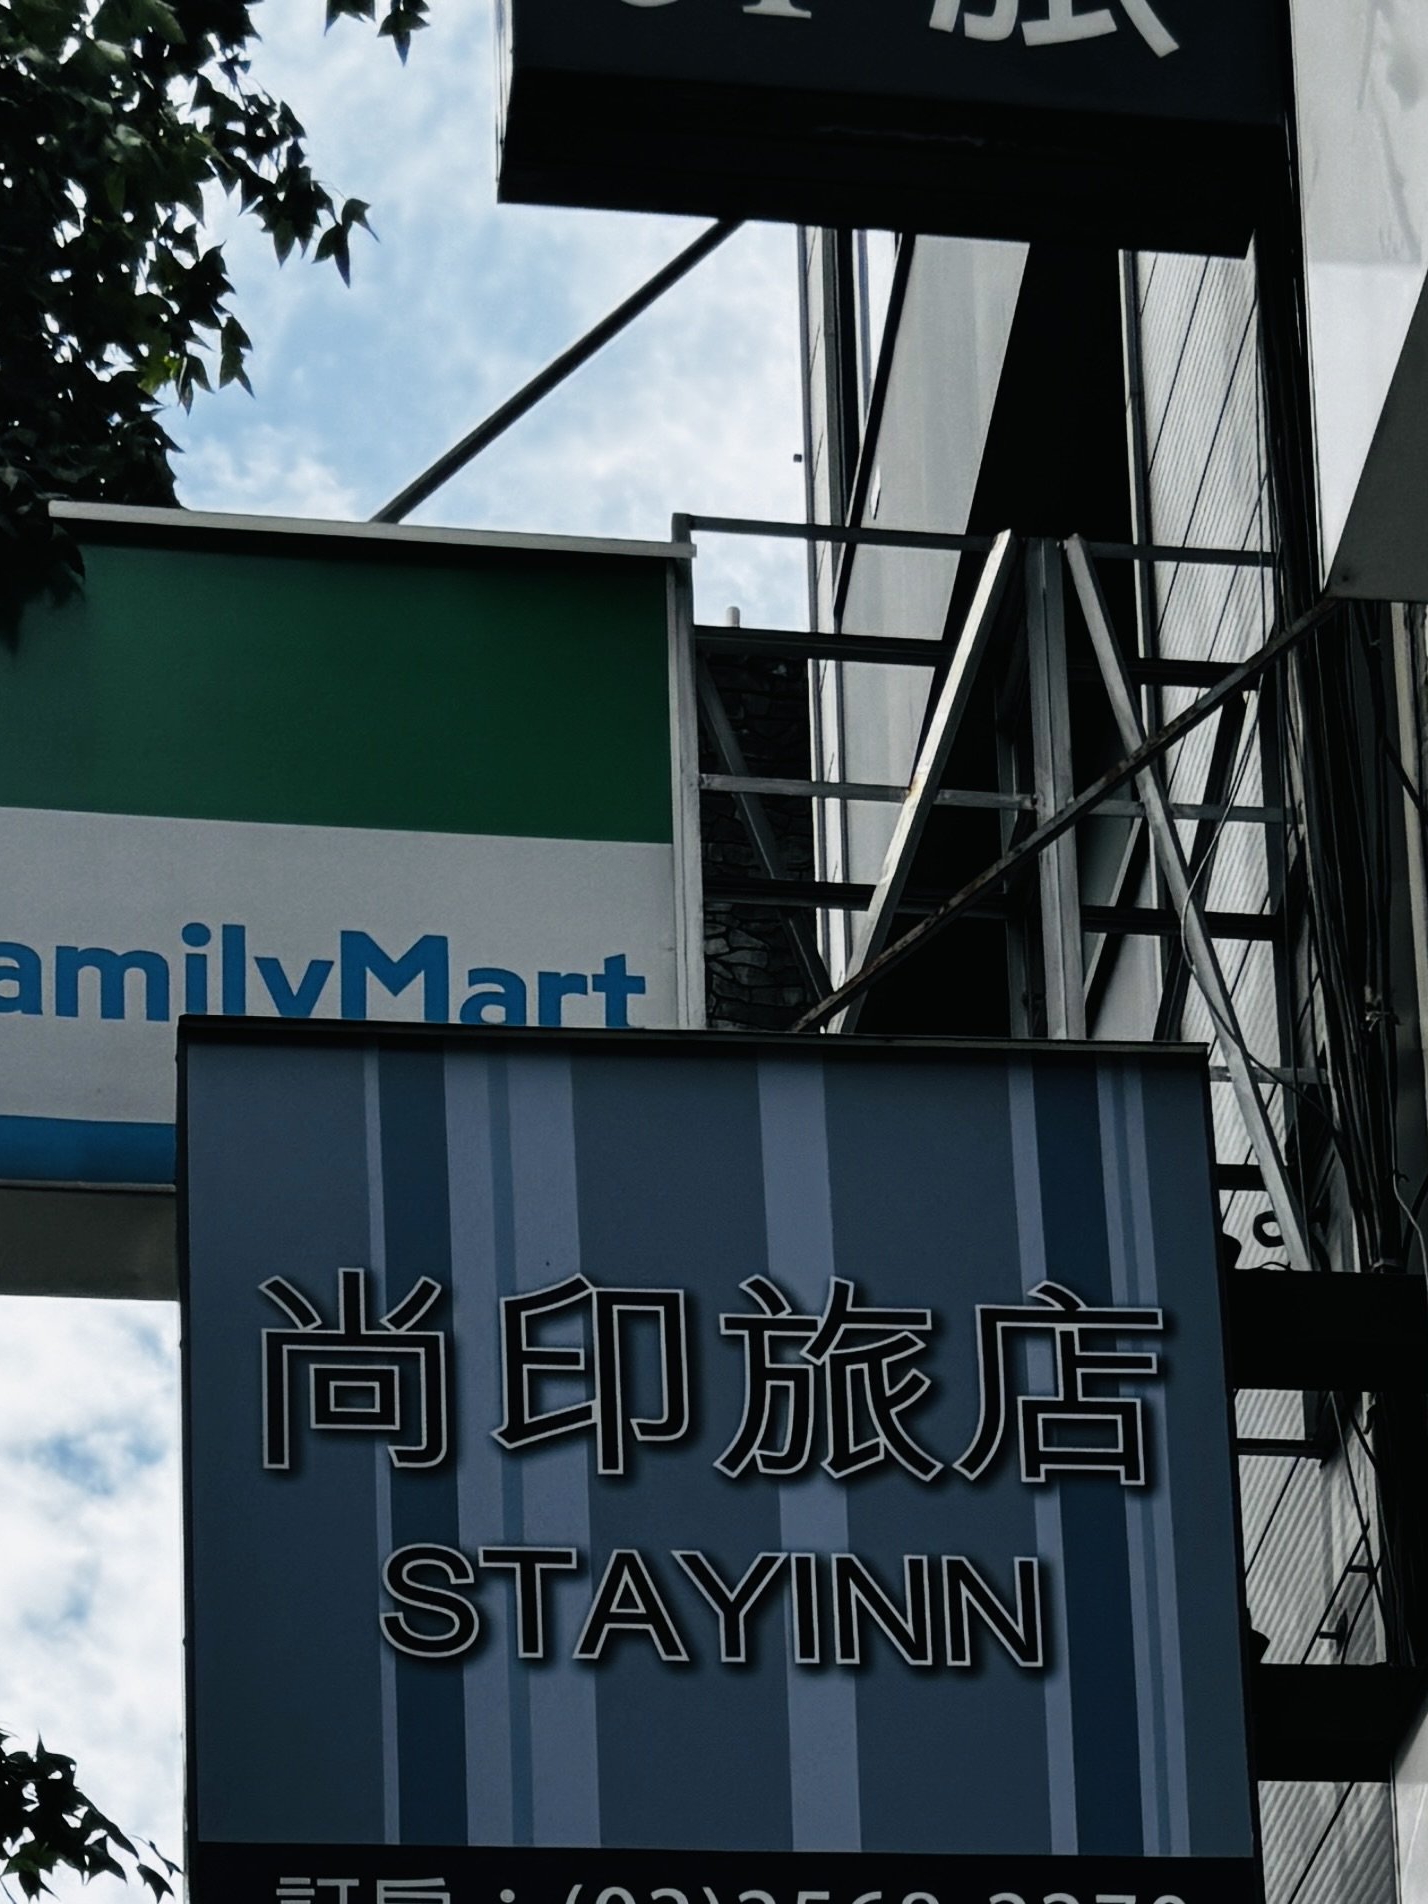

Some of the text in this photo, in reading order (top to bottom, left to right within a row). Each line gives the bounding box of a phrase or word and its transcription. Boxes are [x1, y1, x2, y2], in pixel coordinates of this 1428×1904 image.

[258, 1266, 1165, 1488] 尚印旅店
[379, 1542, 1044, 1669] STAYINN
